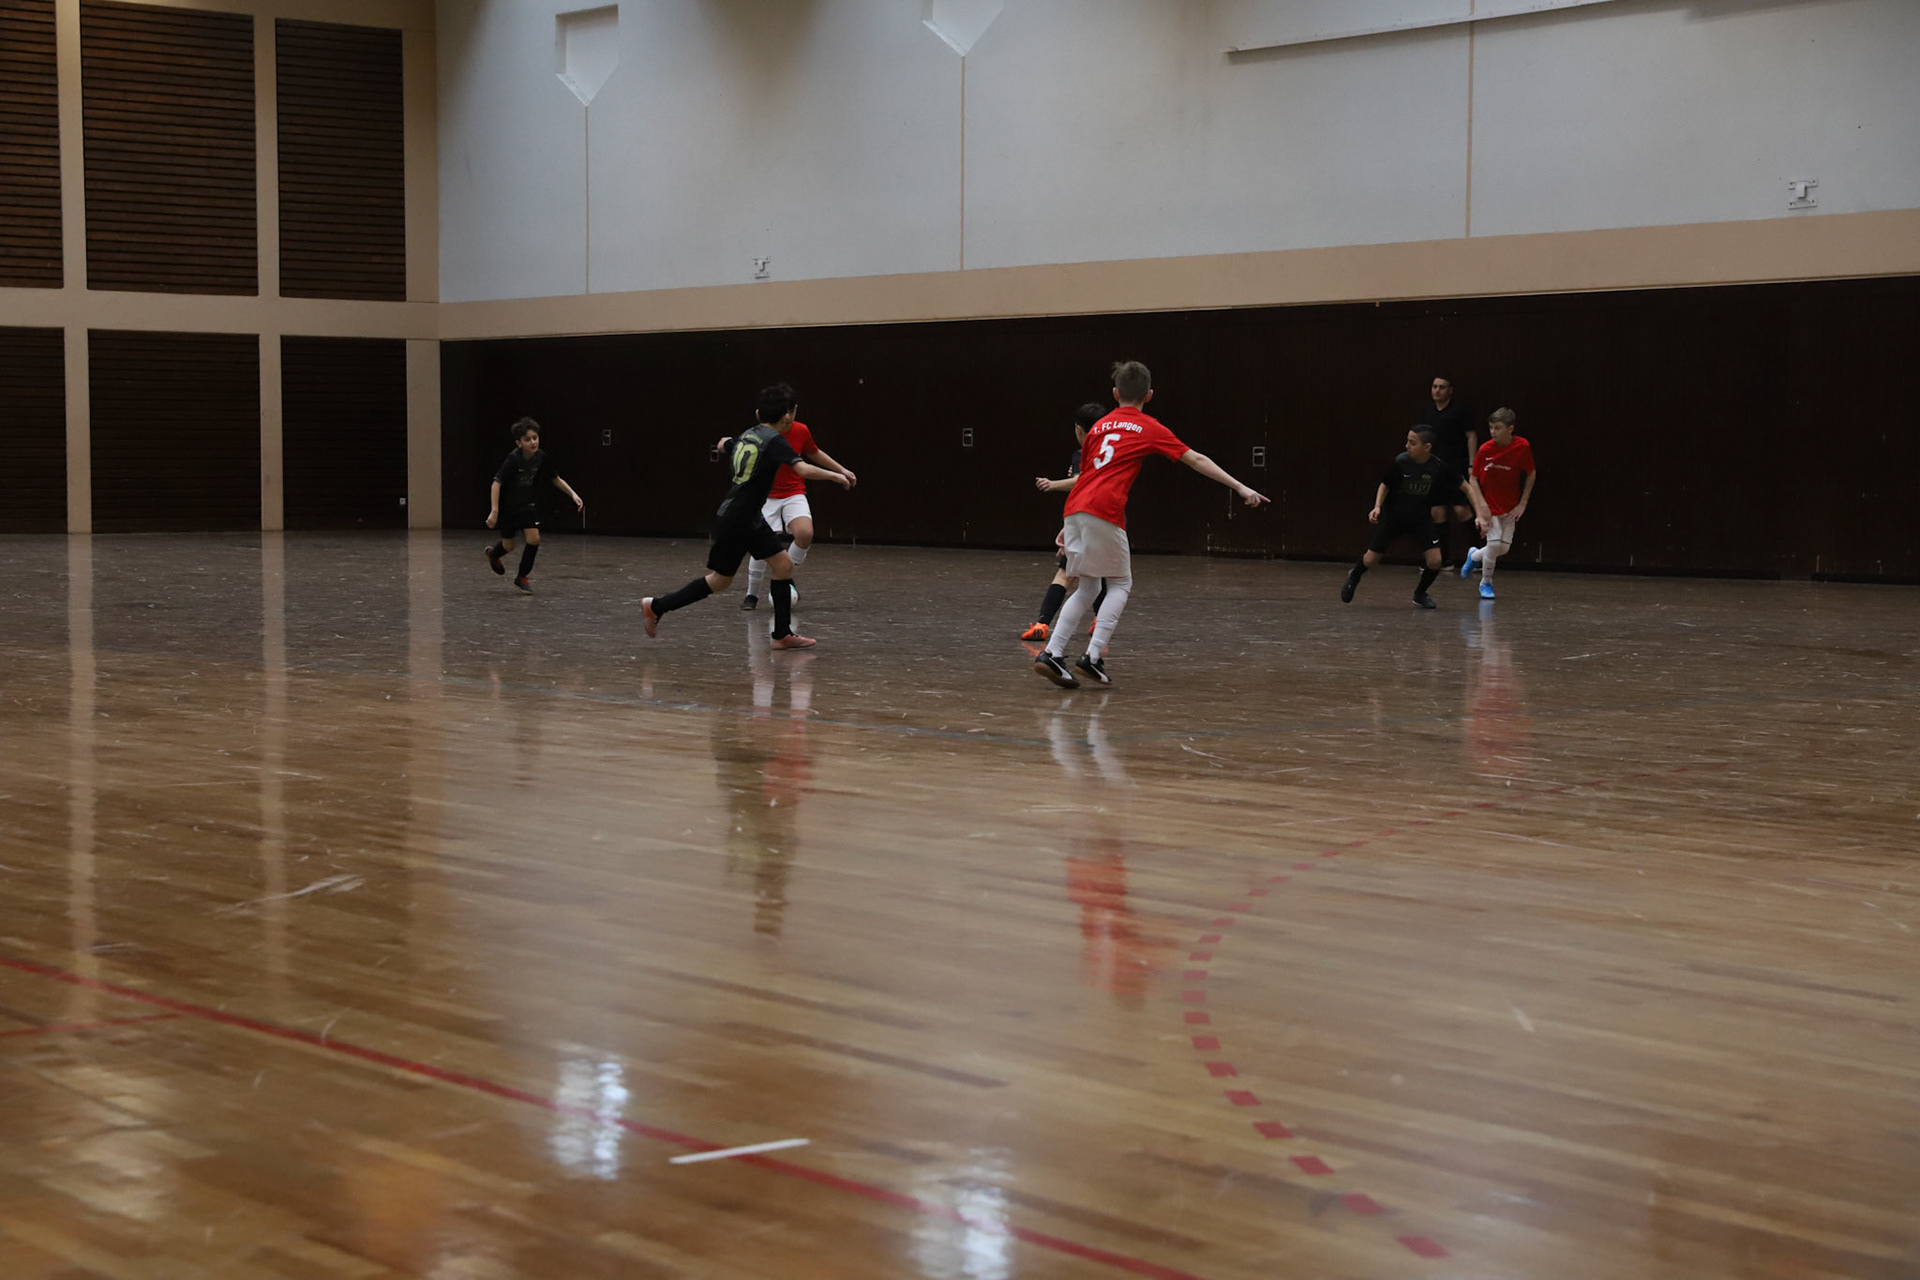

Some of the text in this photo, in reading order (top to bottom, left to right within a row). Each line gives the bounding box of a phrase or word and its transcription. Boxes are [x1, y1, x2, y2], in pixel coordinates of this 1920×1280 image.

[1102, 421, 1112, 430] FC
[1113, 420, 1143, 434] Langen
[732, 441, 759, 486] 10
[1093, 433, 1121, 470] 5
